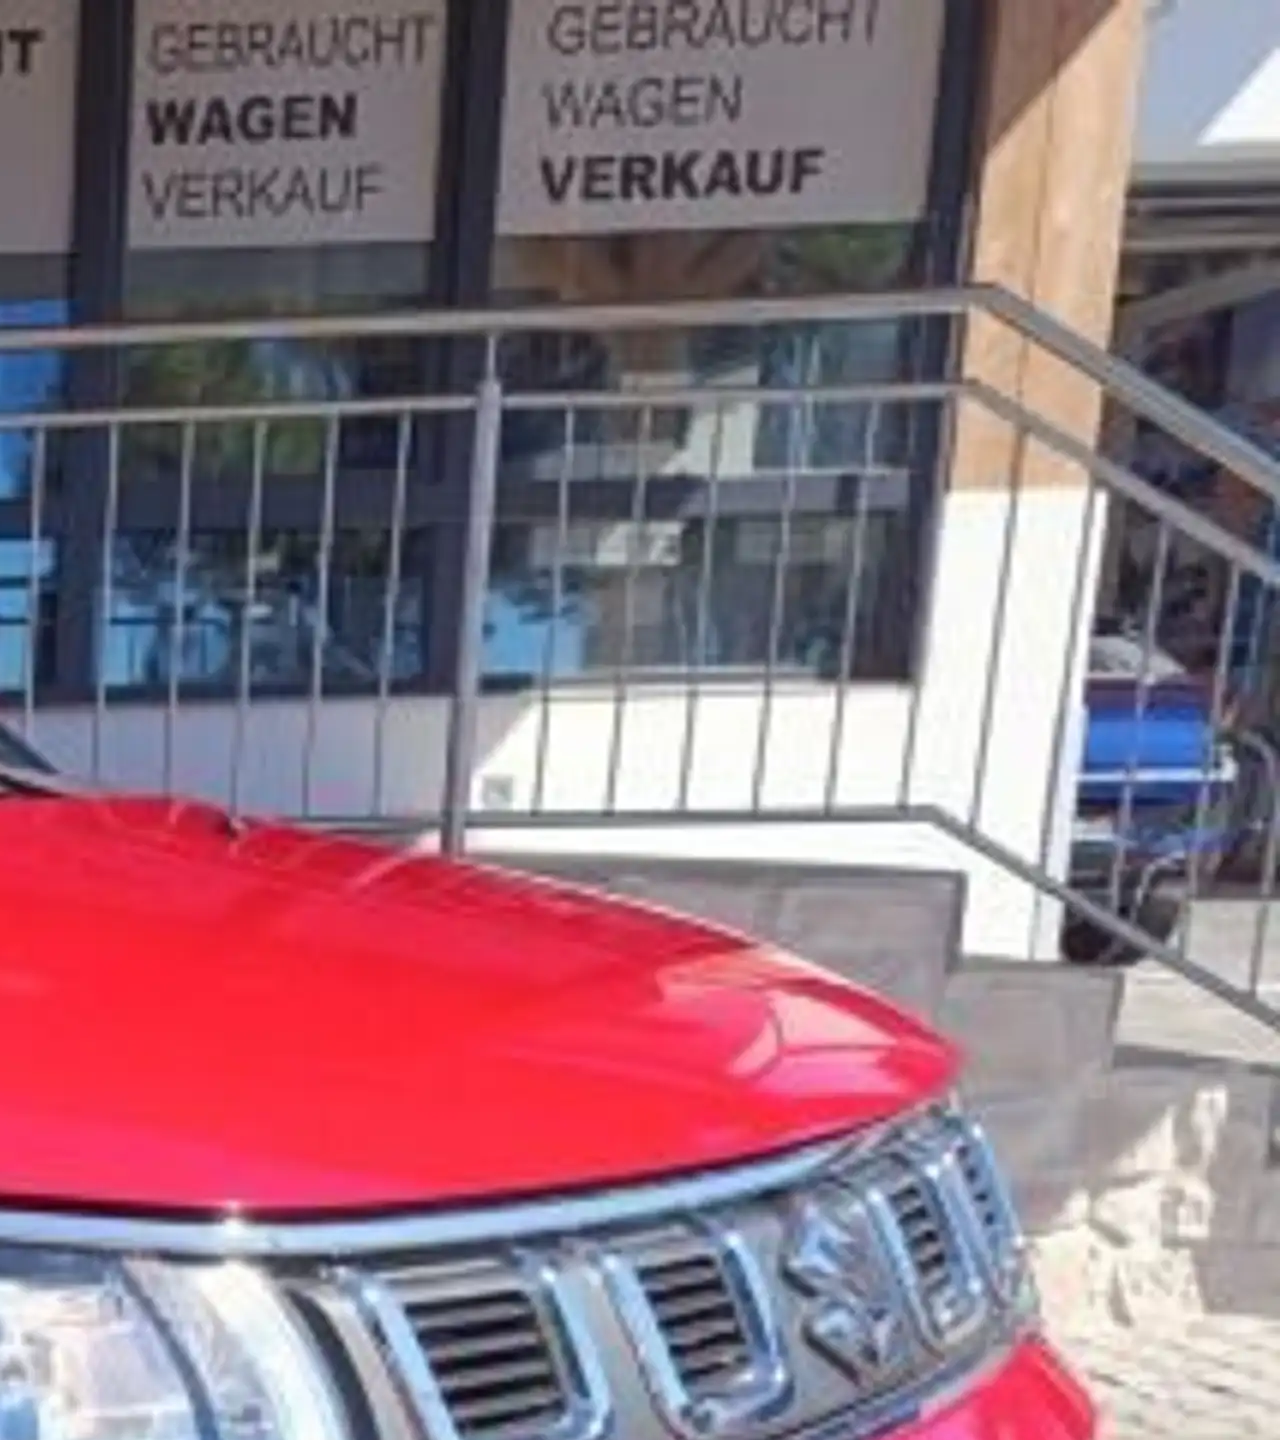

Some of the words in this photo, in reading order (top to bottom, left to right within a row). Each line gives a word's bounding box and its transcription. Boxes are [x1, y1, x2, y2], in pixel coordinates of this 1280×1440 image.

[149, 14, 434, 75] GEBRAUCHT
[547, 0, 879, 56] GEBRAUCHT
[145, 92, 357, 145] WAGEN
[543, 74, 743, 129] WAGEN
[143, 161, 385, 220] VERKAUF
[541, 148, 826, 204] VERKAUF
